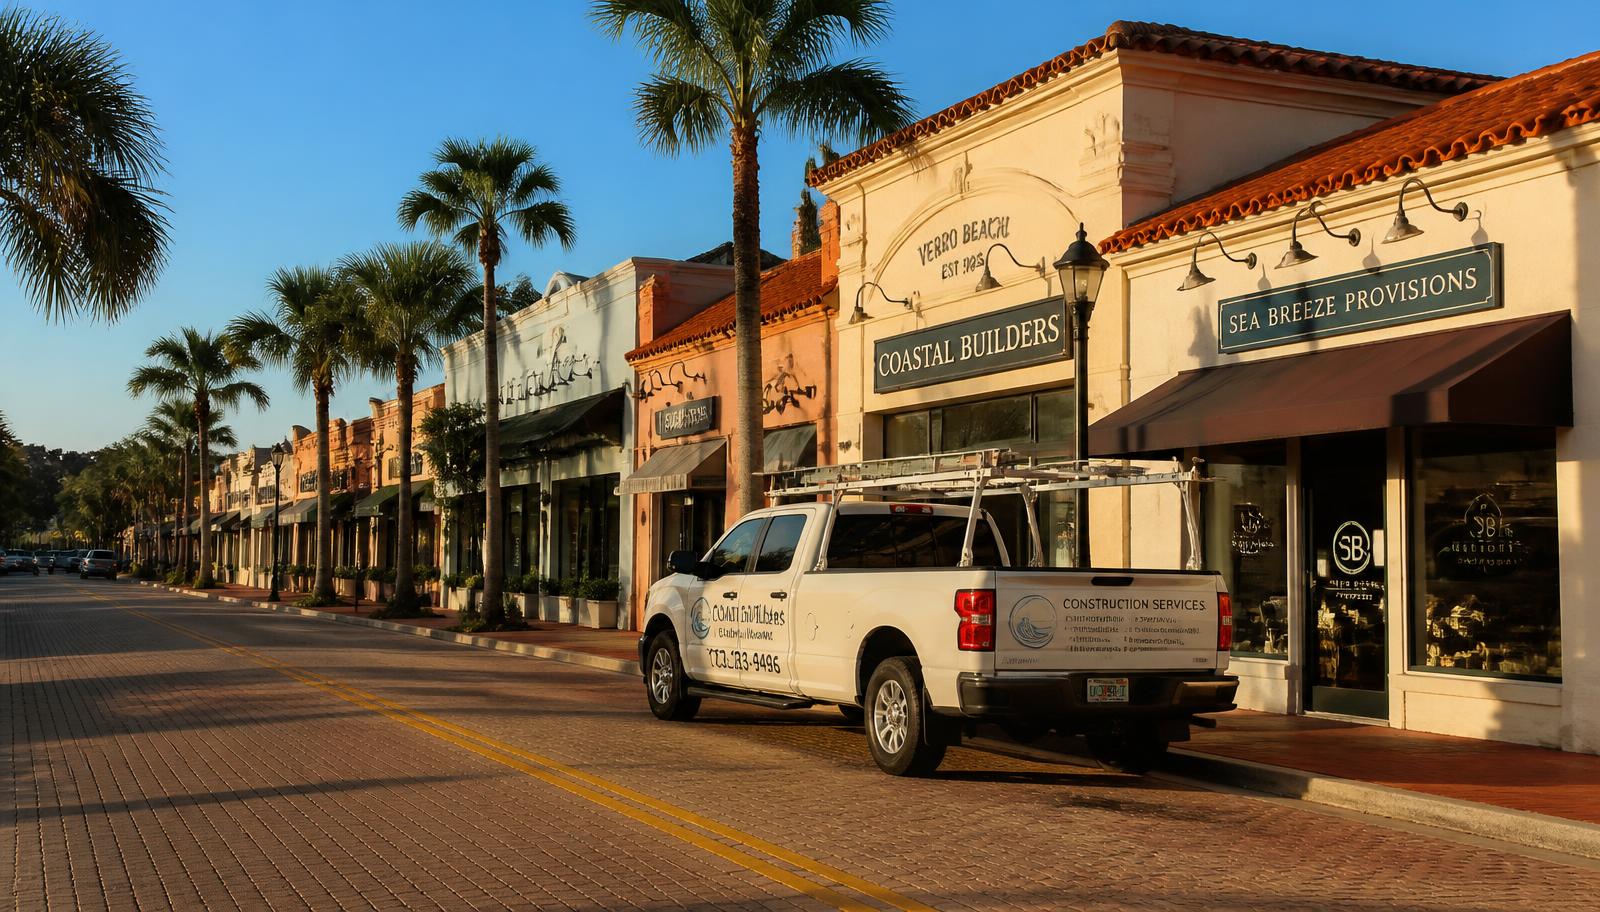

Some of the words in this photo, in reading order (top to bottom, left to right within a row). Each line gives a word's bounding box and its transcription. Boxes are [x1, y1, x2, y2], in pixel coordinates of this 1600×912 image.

[917, 228, 958, 266] VERRO
[941, 259, 959, 280] EST
[1229, 312, 1261, 335] SEA
[1268, 295, 1336, 327] BREEZE
[1345, 267, 1478, 313] PROVISIONS
[879, 339, 955, 377] COASTAL
[960, 314, 1060, 361] BUILDERS
[1338, 535, 1367, 561] SB
[1063, 598, 1149, 610] CONSTRUCTION
[1152, 599, 1207, 611] SERVICES
